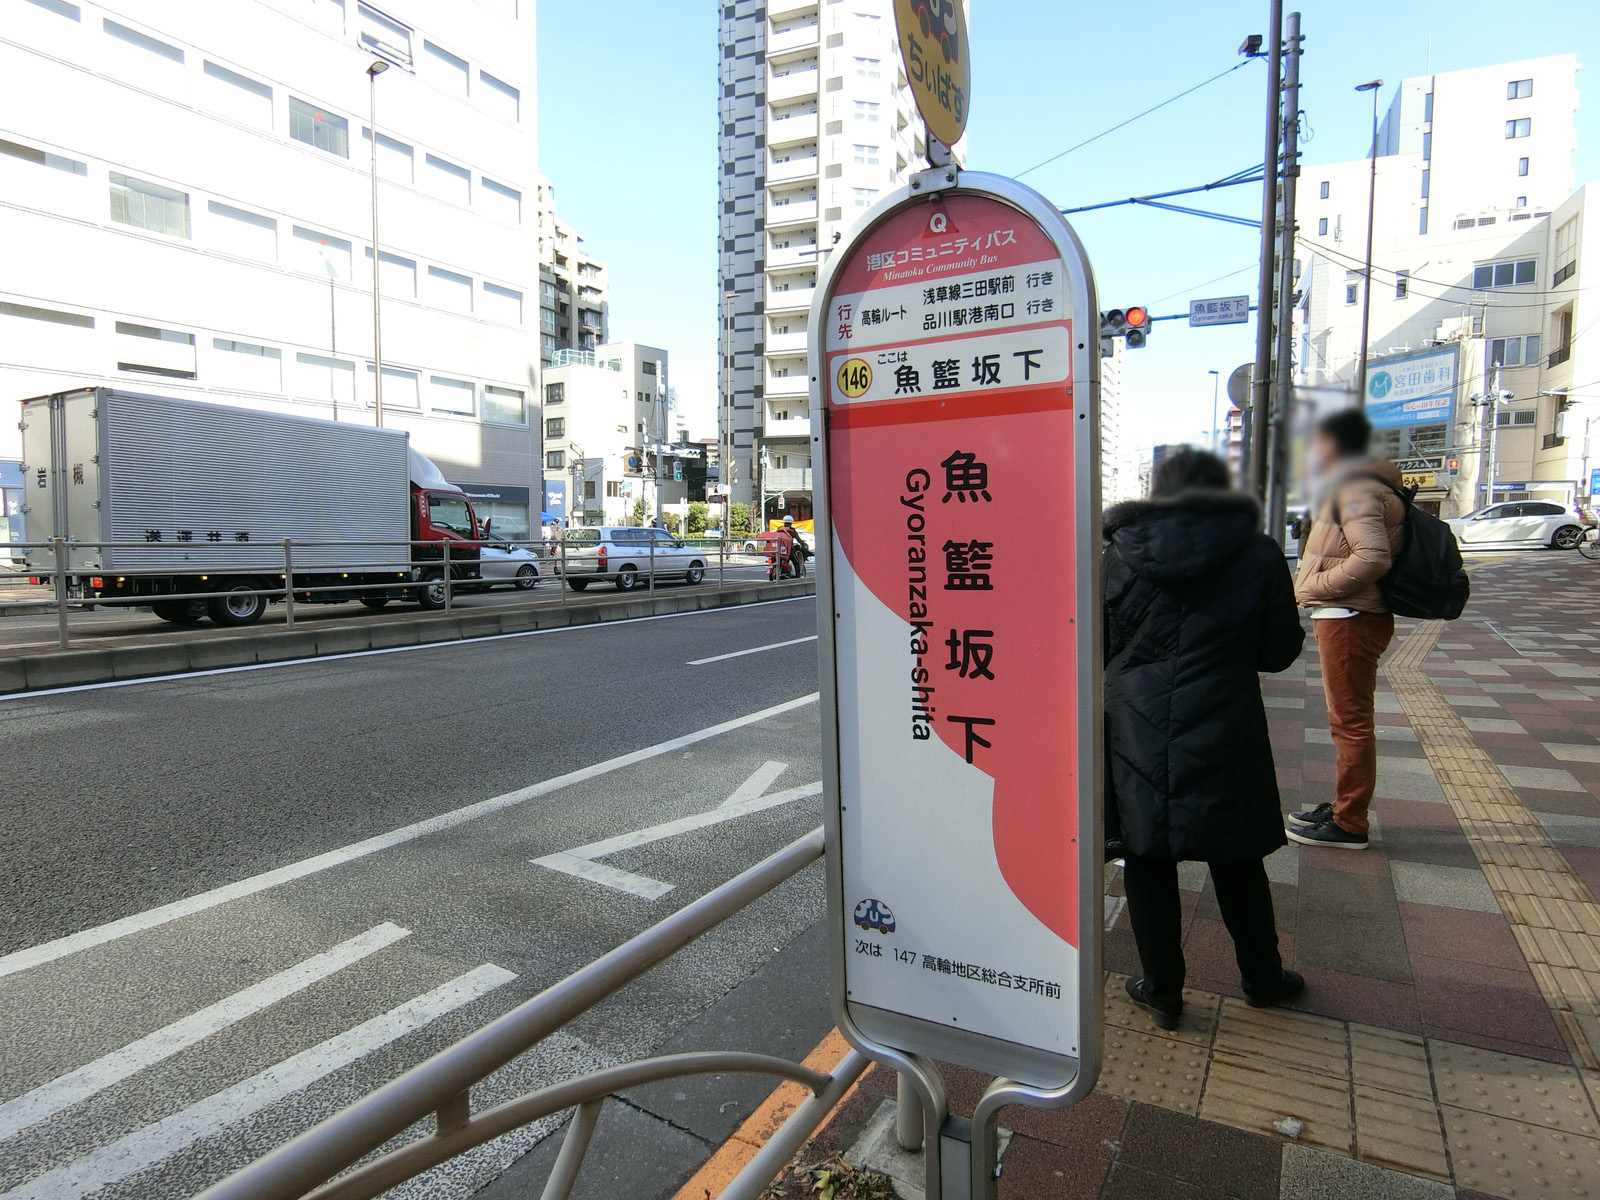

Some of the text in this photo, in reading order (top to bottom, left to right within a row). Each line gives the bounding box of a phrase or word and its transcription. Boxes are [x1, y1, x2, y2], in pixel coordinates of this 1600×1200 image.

[929, 213, 947, 233] Q
[866, 229, 1017, 271] 港区コミュニティバス
[883, 254, 998, 281] Minatoku Community Bus
[923, 271, 1054, 305] 浅草線三田駅前 行き
[861, 305, 907, 326] 高輪ルート
[923, 299, 1054, 331] 品川駅港南口 行き
[1192, 313, 1234, 322] Gyoran-zaka
[1194, 299, 1244, 315] 魚籃坂下
[838, 304, 852, 340] 行先
[877, 351, 908, 365] ここは
[894, 349, 1043, 395] 魚籃坂下
[842, 364, 868, 391] 146
[1394, 366, 1450, 389] 宮田歯科
[900, 468, 936, 740] Gyoranzaka-shita
[940, 450, 996, 764] 魚籃坂下
[855, 939, 1061, 999] 次は 147 高輪地区総合支所前
